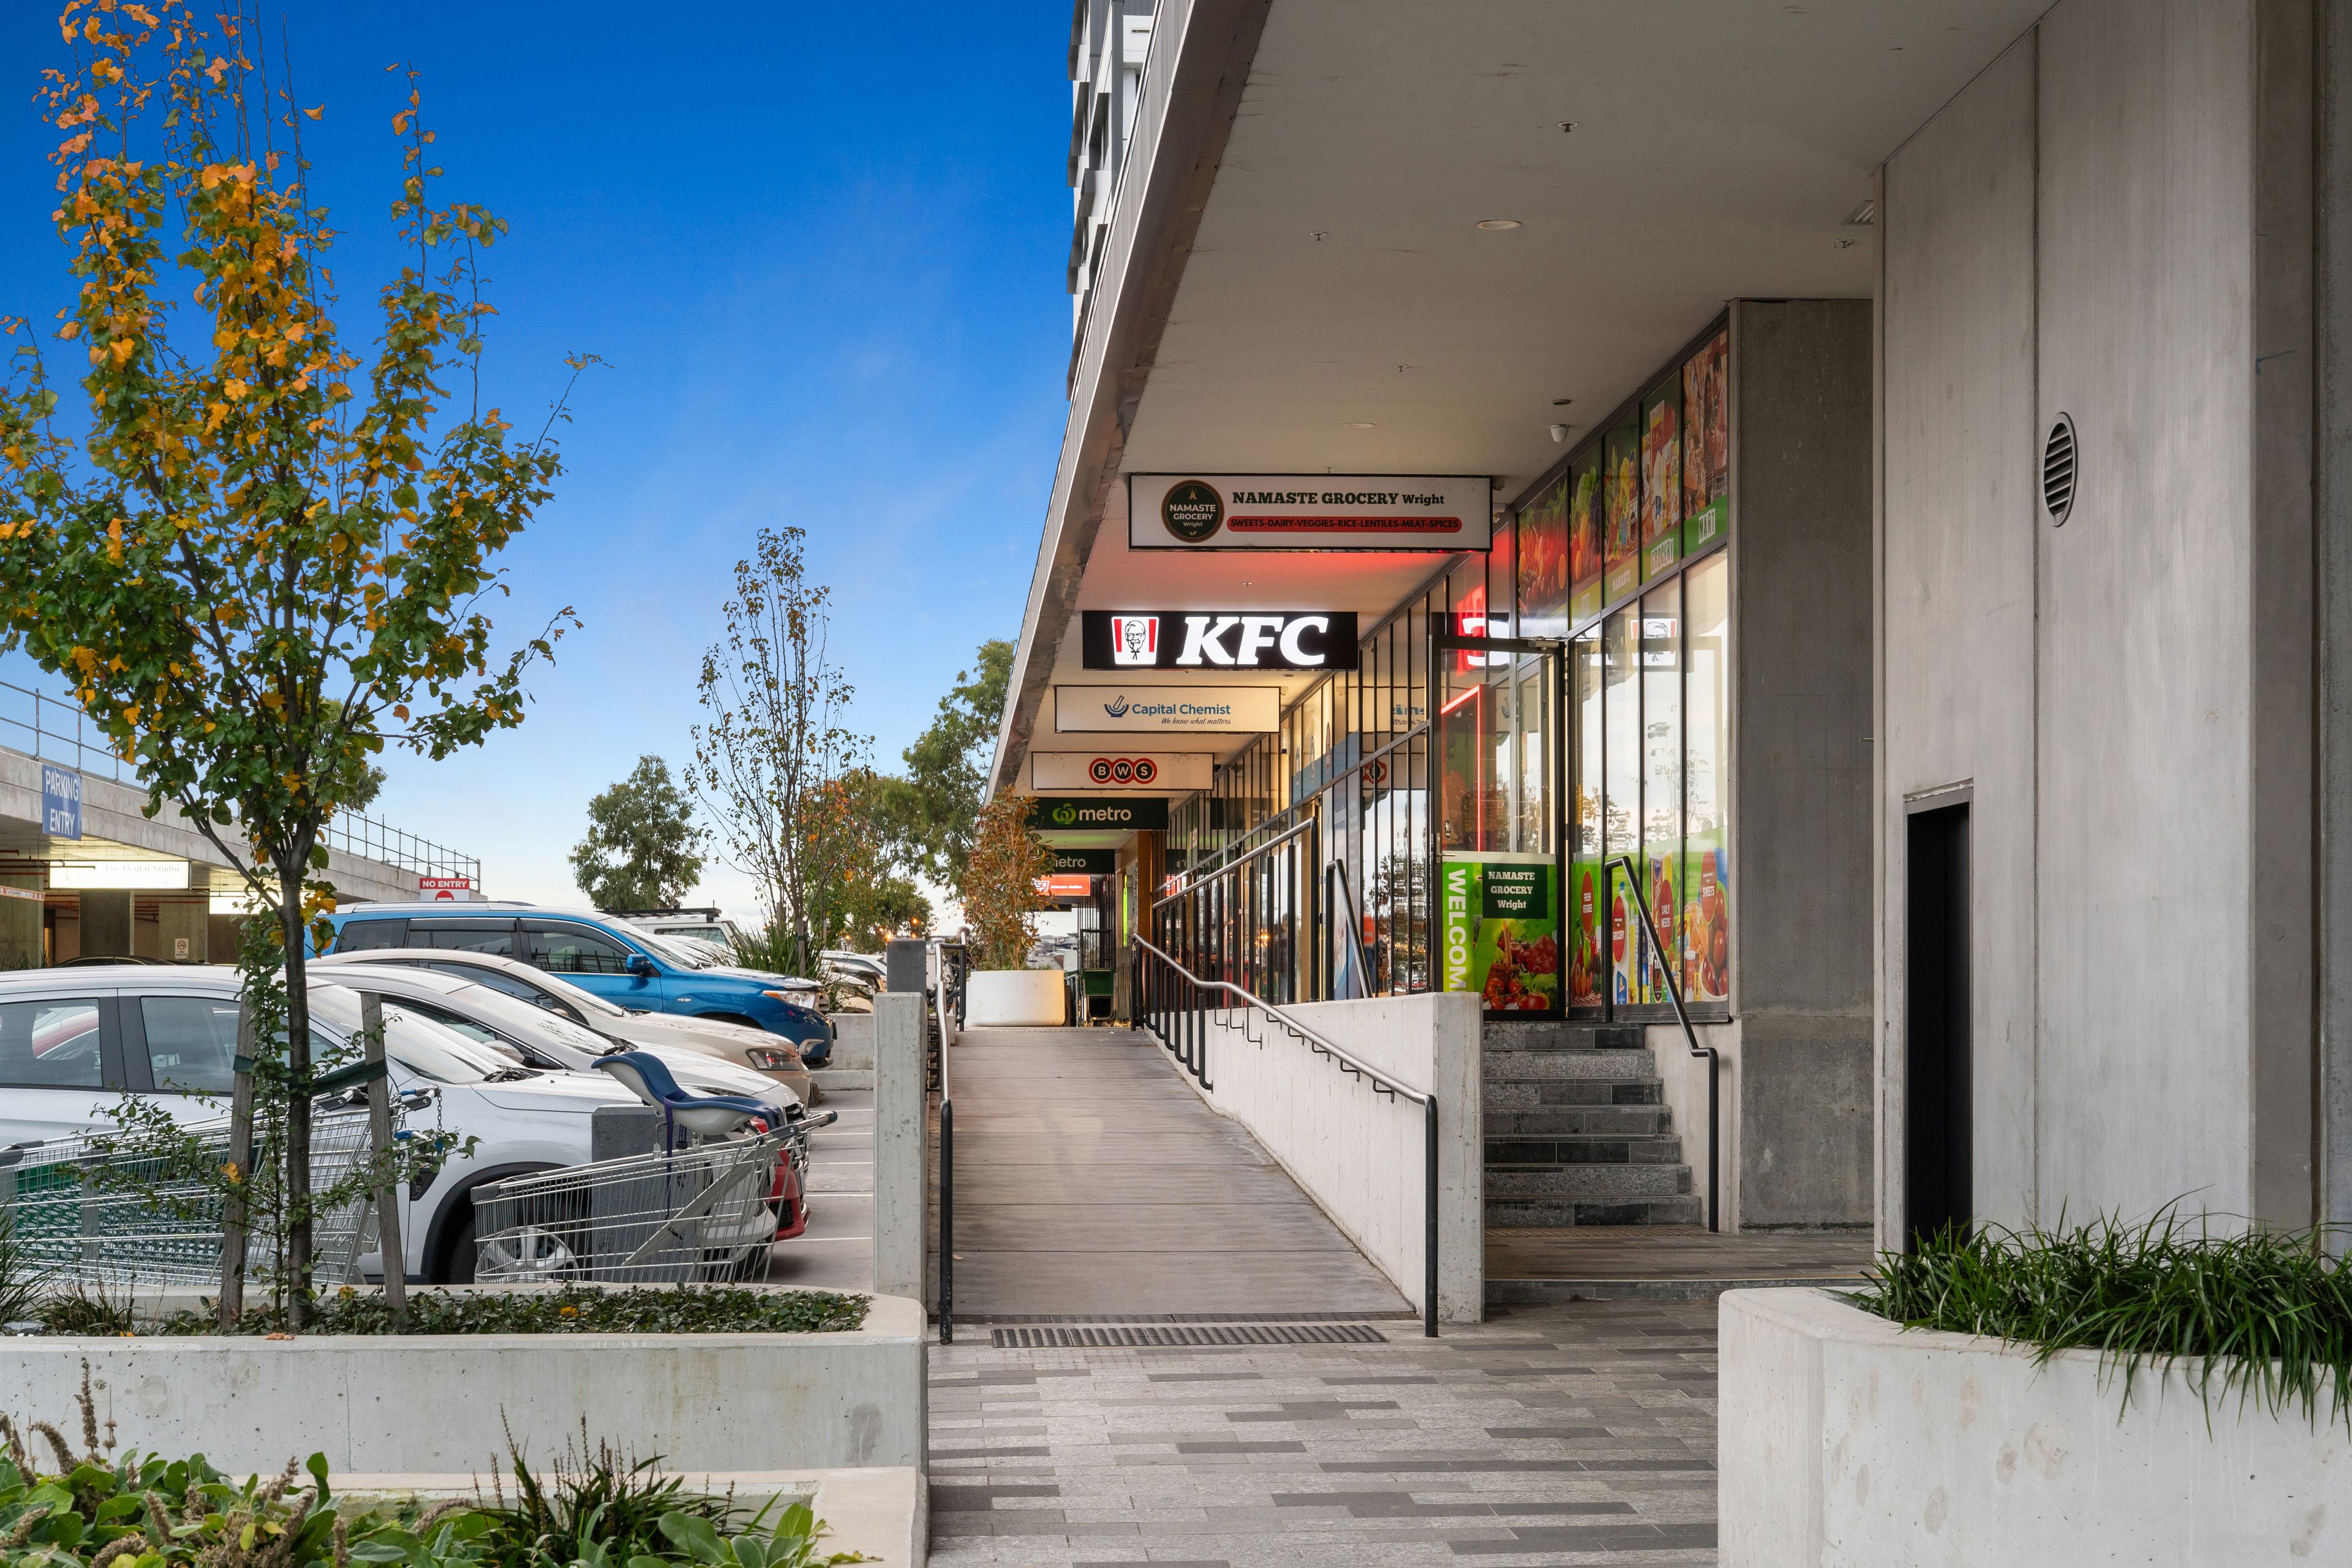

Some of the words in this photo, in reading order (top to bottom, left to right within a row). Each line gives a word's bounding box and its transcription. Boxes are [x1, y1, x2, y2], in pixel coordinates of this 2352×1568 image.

[1232, 492, 1317, 504] NAMASTE
[1321, 492, 1398, 505] GROCERY
[1402, 494, 1444, 507] Wright
[1698, 508, 1716, 545] MART
[1175, 616, 1329, 666] KFC
[1132, 704, 1176, 716] Capital
[1179, 704, 1231, 715] Chemist
[45, 770, 79, 802] PARKING
[1079, 806, 1132, 821] metro
[50, 808, 75, 836] ENTRY
[1488, 871, 1536, 881] NAMASTE
[1490, 886, 1533, 895] GROCERY
[1702, 886, 1715, 898] SWEETS
[1497, 899, 1527, 910] Wright
[1661, 904, 1670, 916] DAILY
[1448, 869, 1467, 992] WELCOM
[1612, 930, 1625, 941] GROCERY
